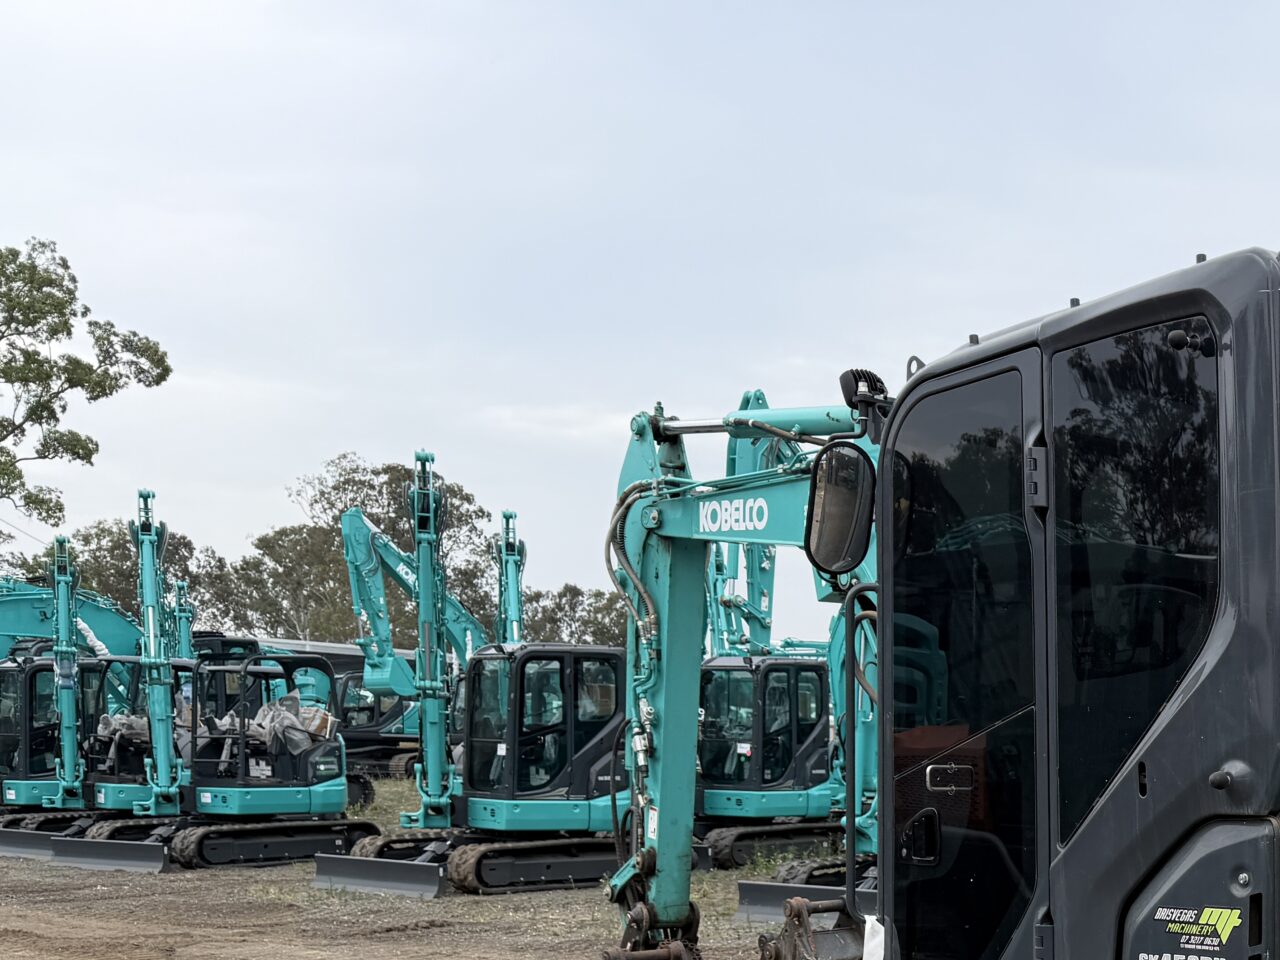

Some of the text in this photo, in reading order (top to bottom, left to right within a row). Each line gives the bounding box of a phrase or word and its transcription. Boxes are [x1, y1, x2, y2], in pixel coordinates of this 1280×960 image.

[699, 497, 769, 533] KOBELCO
[1154, 907, 1198, 922] BRISVEGAS
[1166, 922, 1215, 936] MACHINERY
